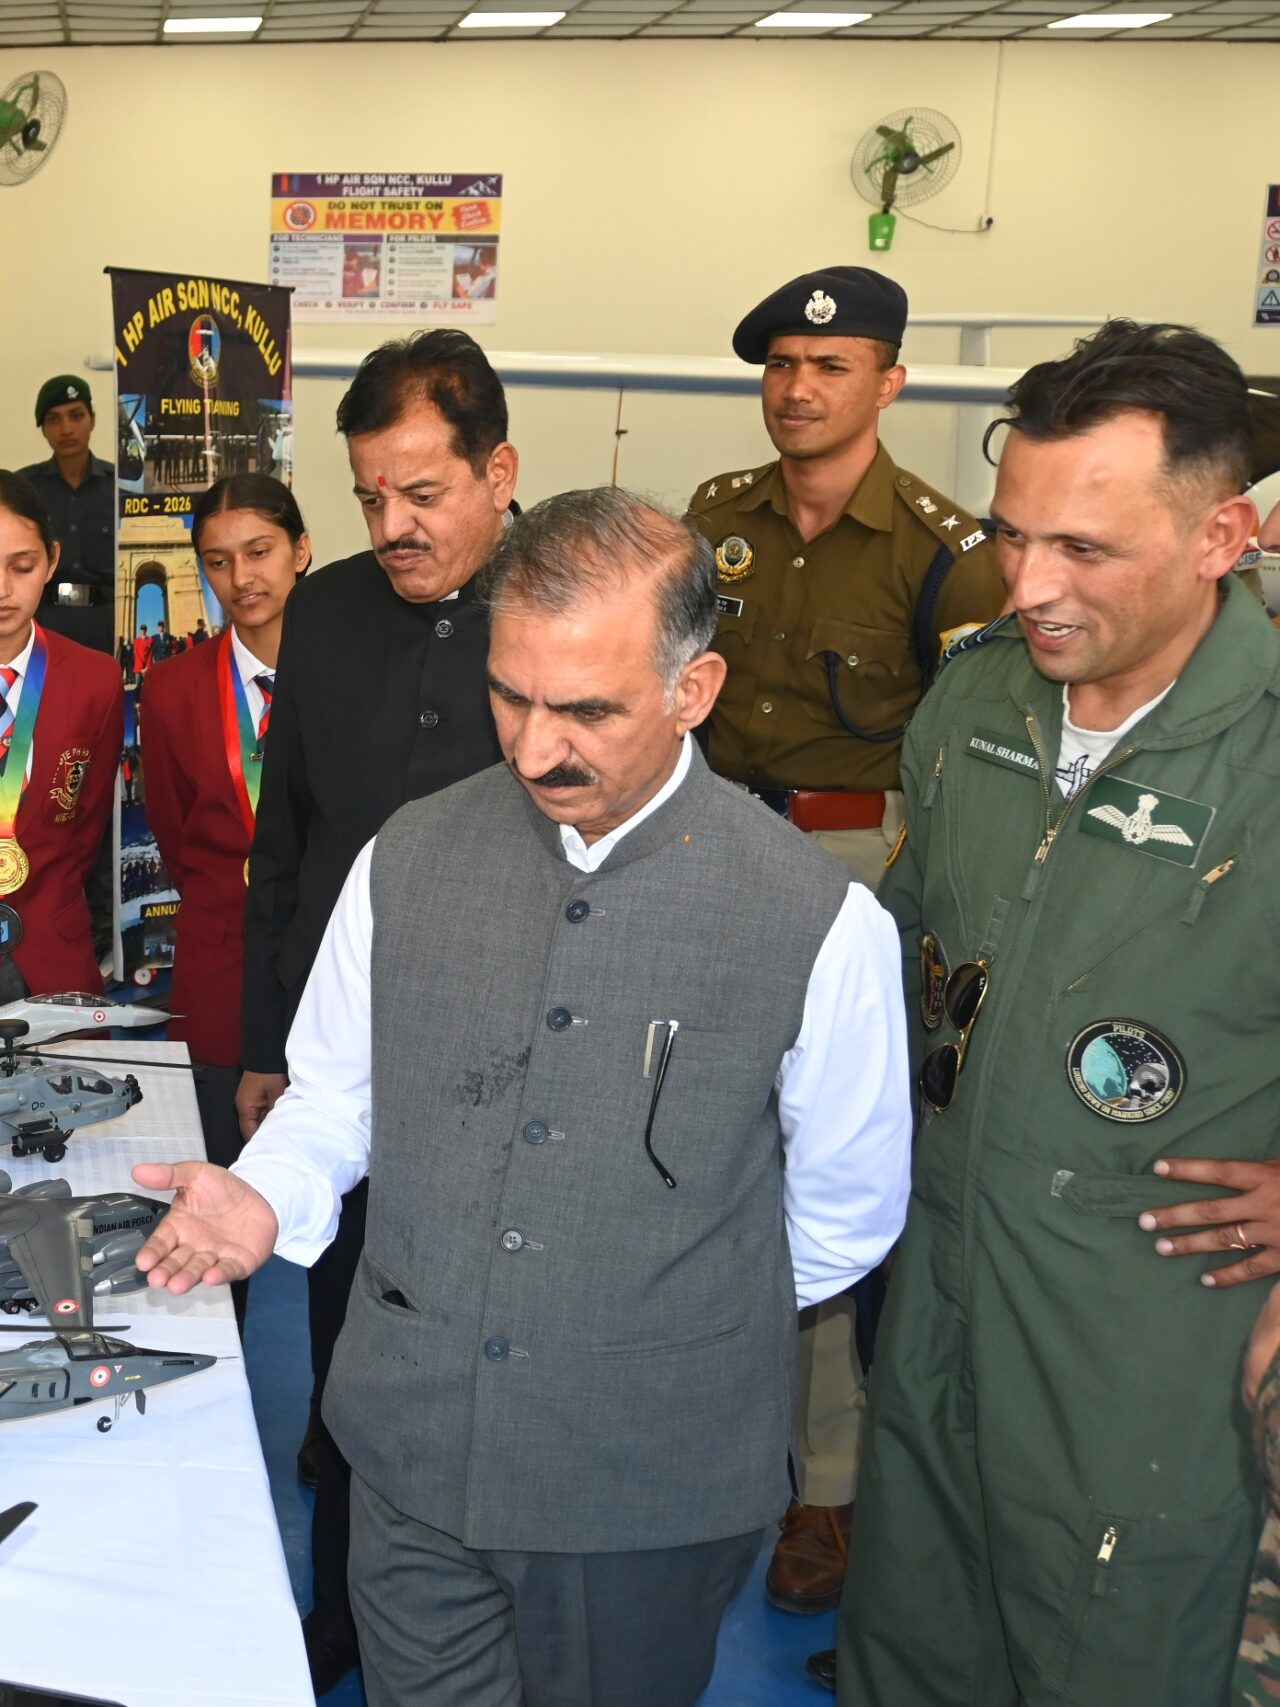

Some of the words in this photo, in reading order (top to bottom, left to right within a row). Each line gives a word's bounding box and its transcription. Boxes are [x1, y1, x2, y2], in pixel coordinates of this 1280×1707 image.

[325, 176, 340, 185] HP
[342, 175, 361, 185] AIR
[363, 175, 387, 185] SQN
[388, 175, 415, 186] NCC,
[417, 175, 452, 184] KULLU
[342, 187, 381, 197] FLIGHT
[383, 186, 425, 196] SAFETY
[327, 201, 346, 211] DO
[350, 201, 376, 211] NOT
[381, 201, 420, 211] TRUST
[425, 201, 444, 211] ON
[325, 212, 446, 230] MEMORY
[122, 311, 145, 353] HP
[148, 287, 176, 328] AIR
[177, 280, 209, 311] SQN
[211, 283, 242, 328] NCC,
[244, 304, 282, 377] KULLU
[161, 399, 201, 415] FLYING
[125, 498, 149, 514] RDC
[164, 496, 191, 513] 2026
[969, 737, 996, 754] KUNAL
[995, 746, 1039, 770] SHARMA
[1113, 1023, 1146, 1039] PILOTS
[93, 1222, 117, 1235] NDIAN
[117, 1219, 131, 1230] AIR
[132, 1215, 153, 1228] FORCE
